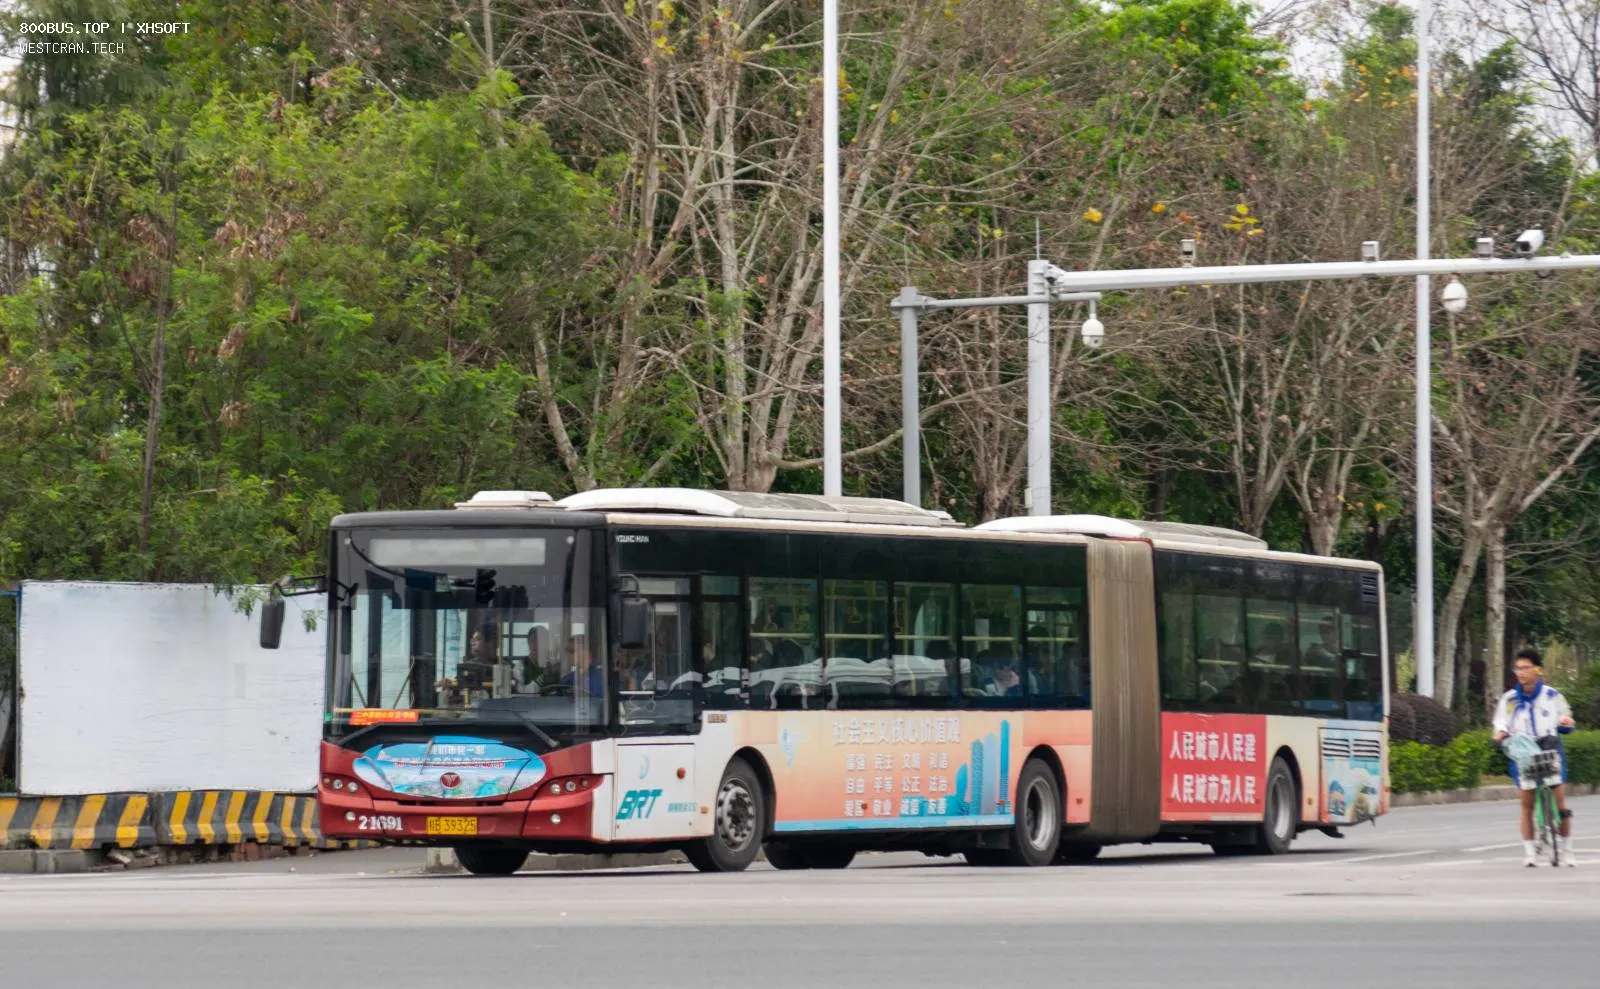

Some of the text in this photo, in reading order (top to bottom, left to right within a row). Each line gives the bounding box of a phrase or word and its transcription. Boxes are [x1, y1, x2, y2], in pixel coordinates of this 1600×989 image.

[833, 717, 961, 745] 社会主义核心价值观
[1170, 730, 1257, 763] 人民城市人民建
[615, 788, 664, 820] BRT
[1170, 773, 1257, 805] 人民城市为人民
[358, 815, 404, 831] 21691
[444, 818, 476, 832] 39325
